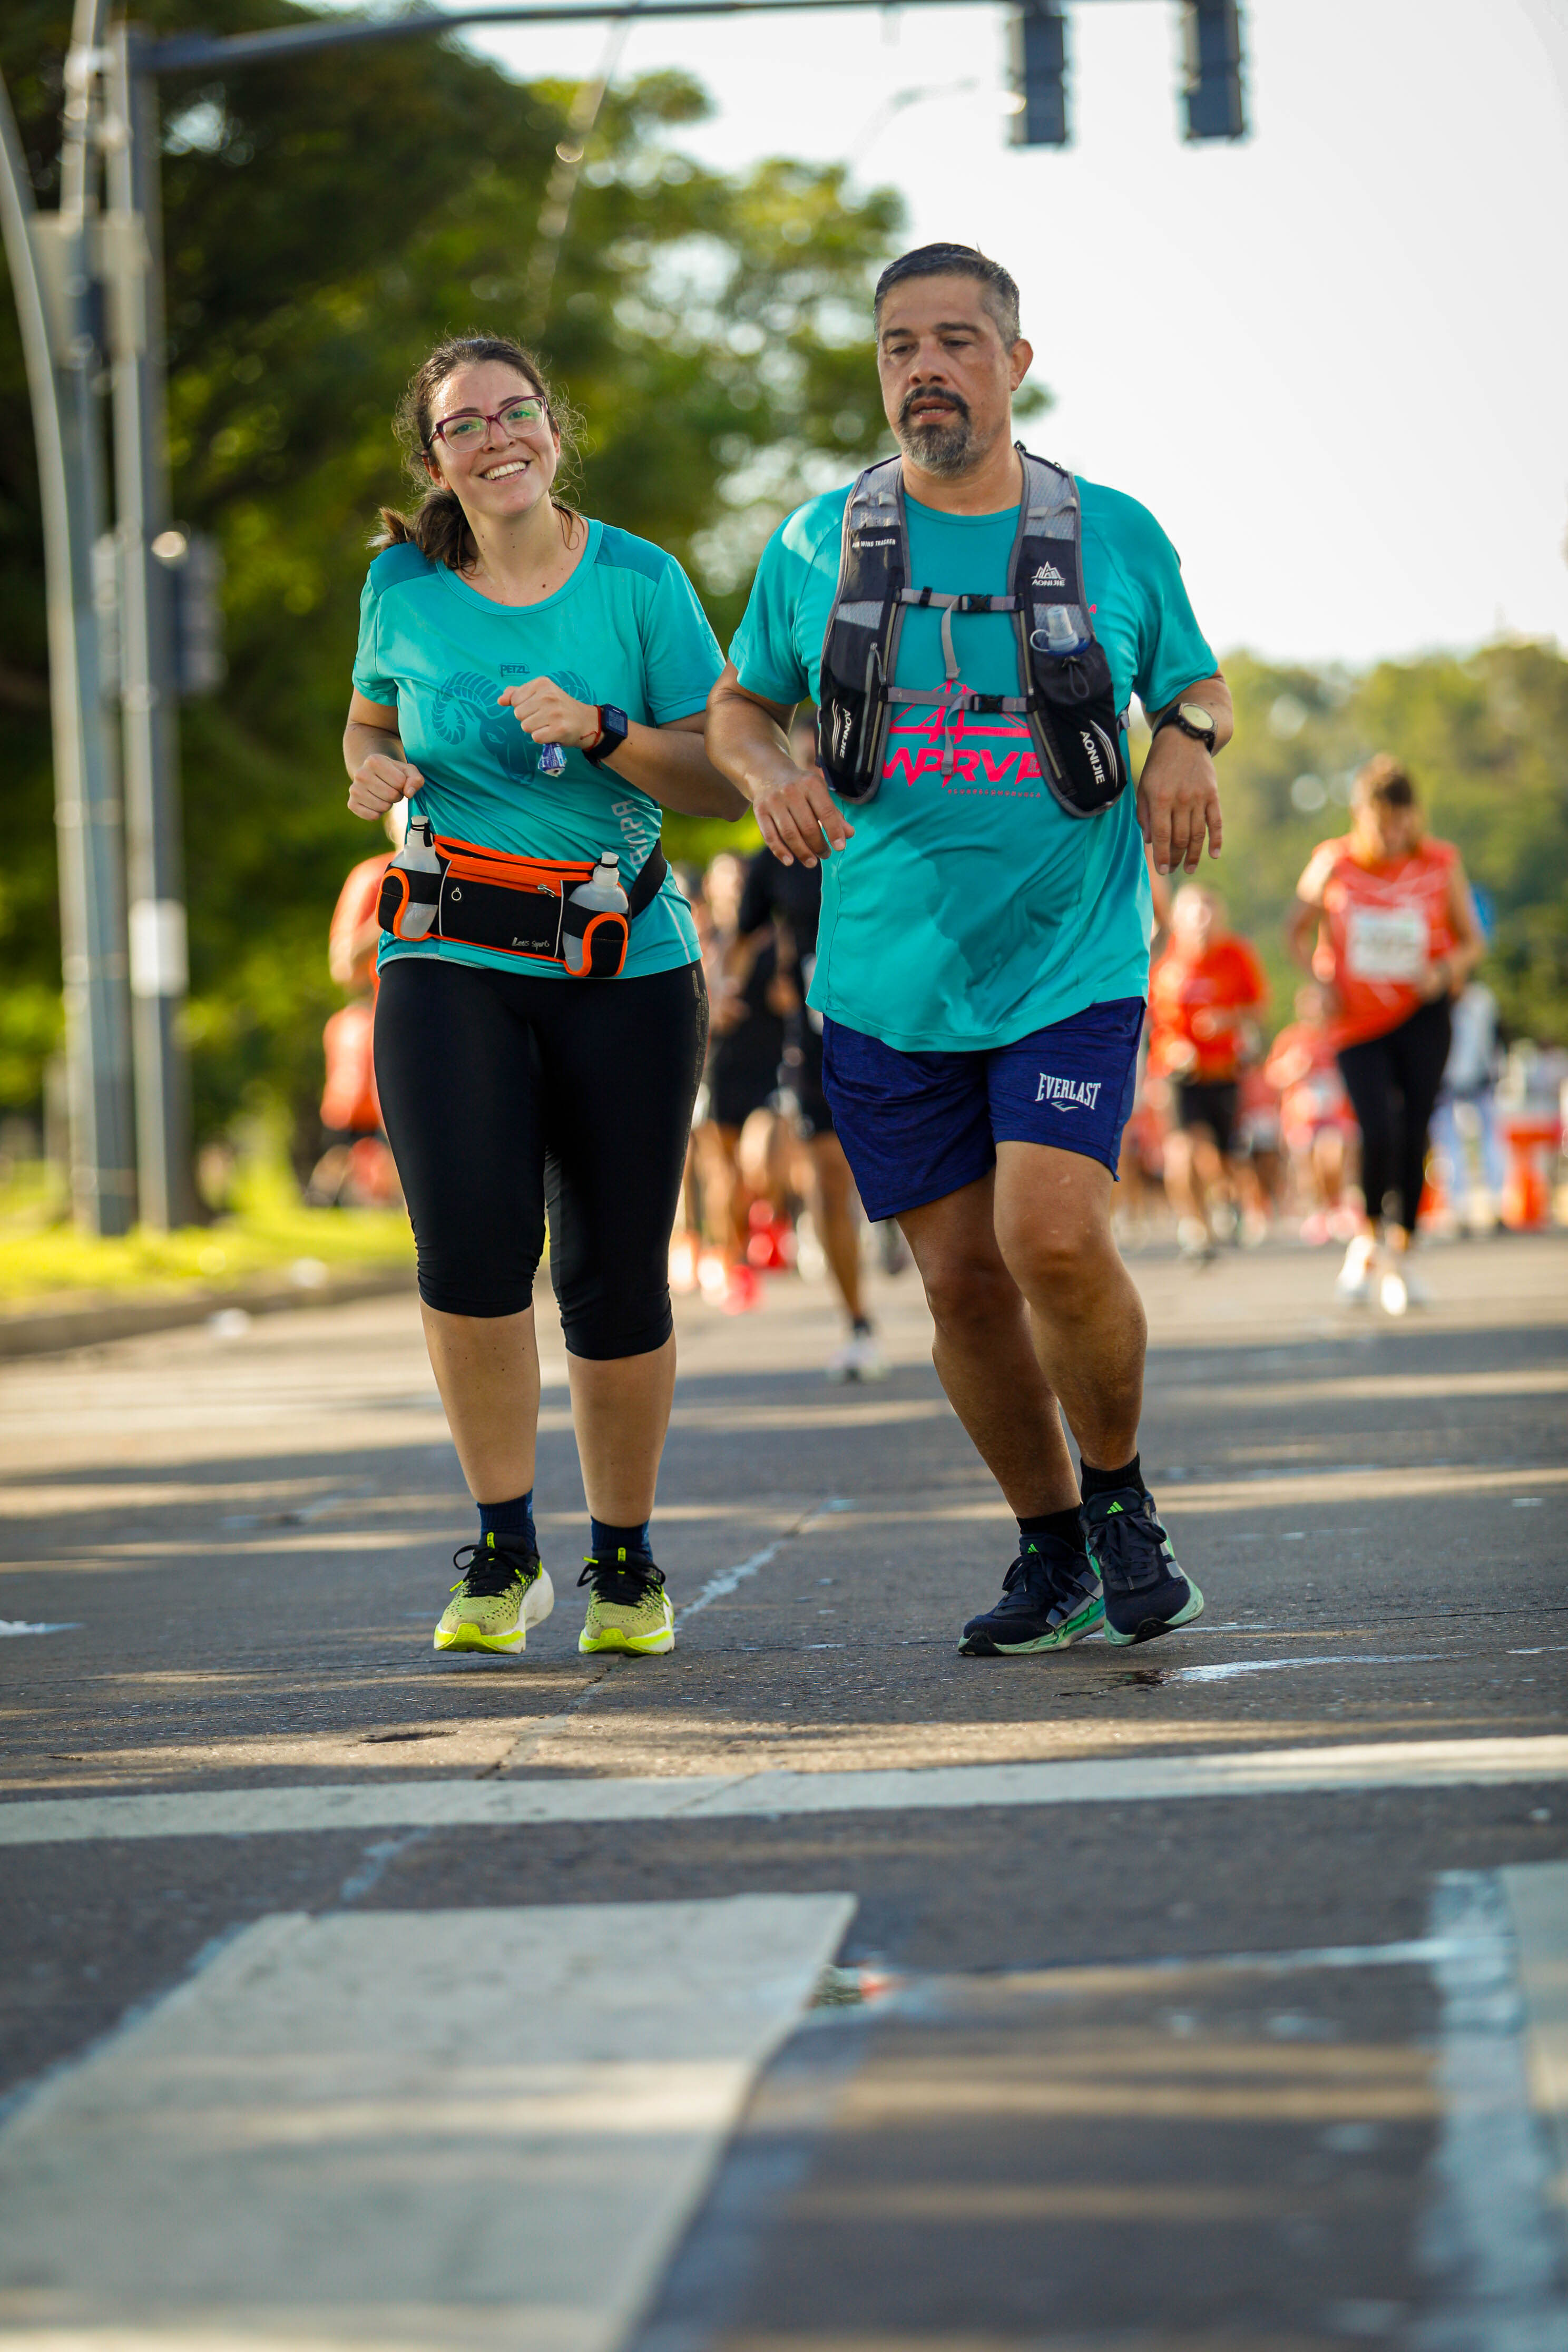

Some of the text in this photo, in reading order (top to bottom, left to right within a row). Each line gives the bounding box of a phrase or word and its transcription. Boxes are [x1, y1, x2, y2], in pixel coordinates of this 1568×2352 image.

[875, 538, 896, 547] TRACKER
[501, 664, 531, 678] PETZL
[839, 708, 851, 759] AONIJIE
[1079, 730, 1105, 785] AONIJIE
[1035, 1072, 1101, 1110] EVERLAST
